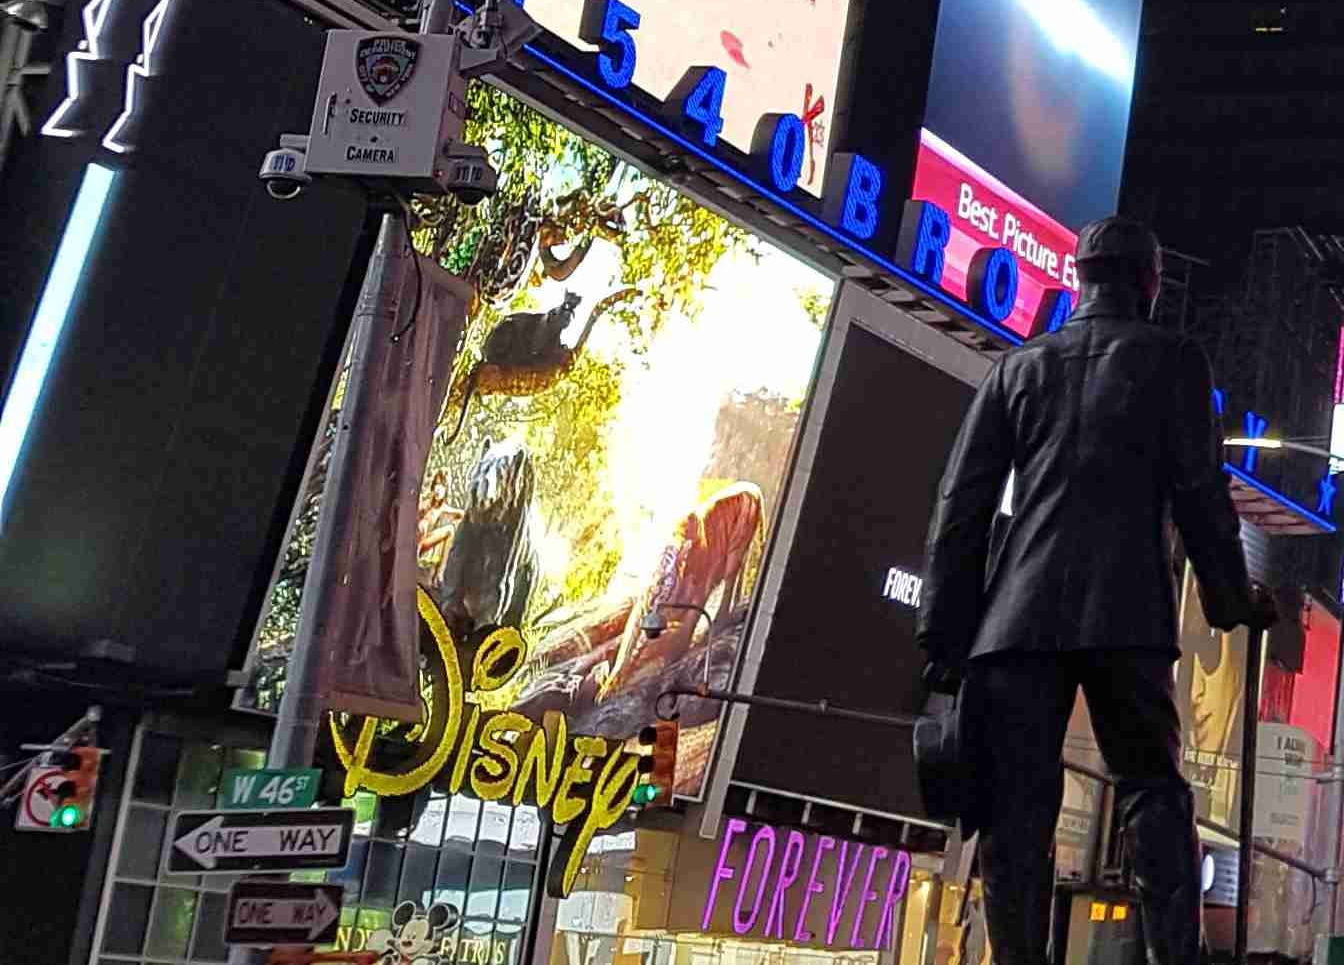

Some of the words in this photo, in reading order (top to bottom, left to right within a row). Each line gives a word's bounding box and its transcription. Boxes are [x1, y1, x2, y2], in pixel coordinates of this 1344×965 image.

[350, 108, 404, 126] SECURITY
[346, 145, 395, 163] CAMERA
[957, 182, 999, 239] Best
[1002, 213, 1060, 279] Picture.
[230, 775, 258, 804] W
[193, 829, 249, 855] ONE
[279, 827, 336, 853] WAY
[701, 817, 912, 952] FOREVER
[237, 902, 273, 925] ONE
[291, 903, 327, 926] WAY
